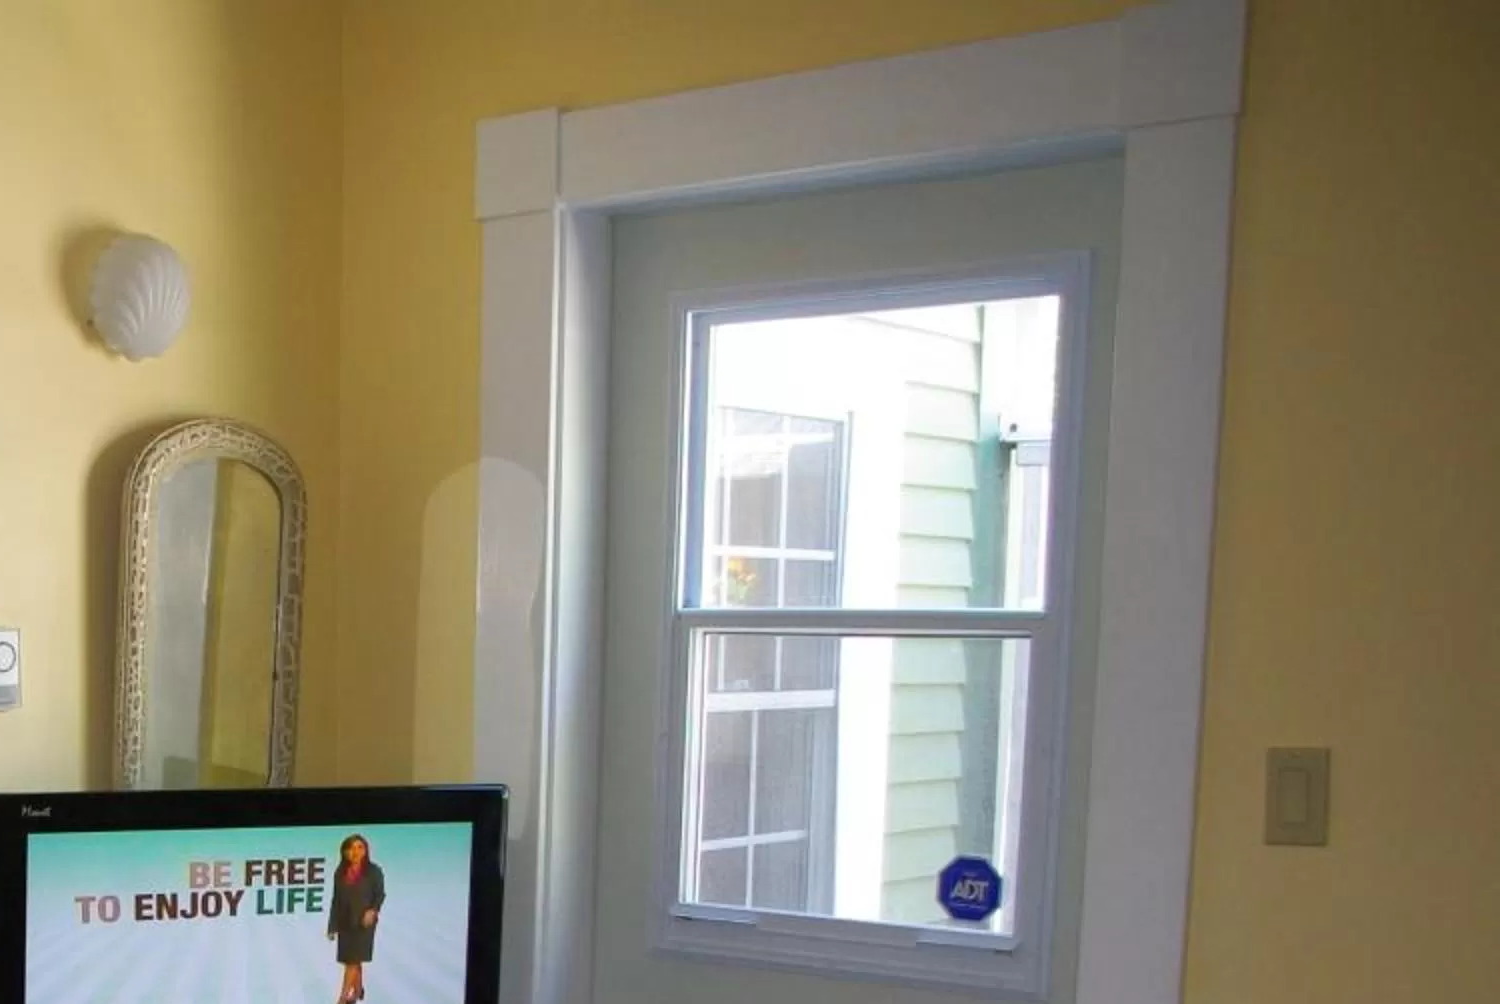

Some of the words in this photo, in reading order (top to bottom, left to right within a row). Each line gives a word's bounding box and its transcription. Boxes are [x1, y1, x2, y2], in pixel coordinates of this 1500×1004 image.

[189, 862, 232, 888] BE
[245, 858, 325, 886] FREE
[74, 895, 121, 924] TO
[135, 890, 244, 921] ENJOY
[256, 887, 324, 915] LIFE
[950, 879, 989, 902] ADT
